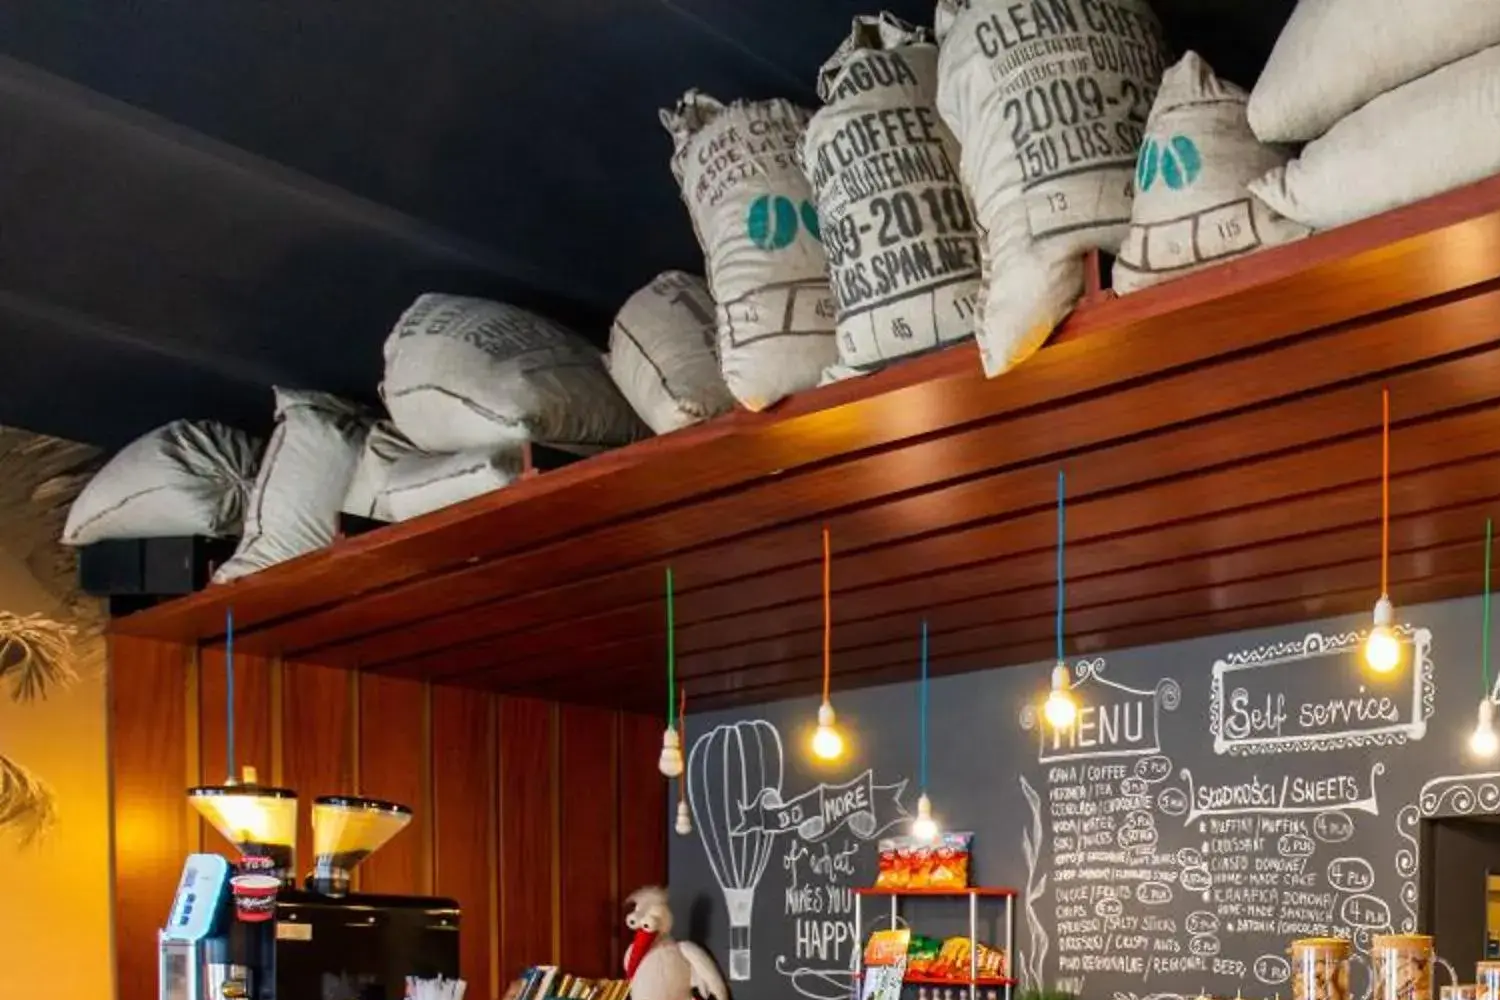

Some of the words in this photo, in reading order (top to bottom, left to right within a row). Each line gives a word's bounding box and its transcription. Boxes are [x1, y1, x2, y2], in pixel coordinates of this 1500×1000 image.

[975, 0, 1078, 60] CLEAN
[832, 106, 943, 168] COFFEE
[1015, 135, 1059, 183] 150
[1225, 688, 1288, 740] Self
[823, 785, 869, 825] MORE
